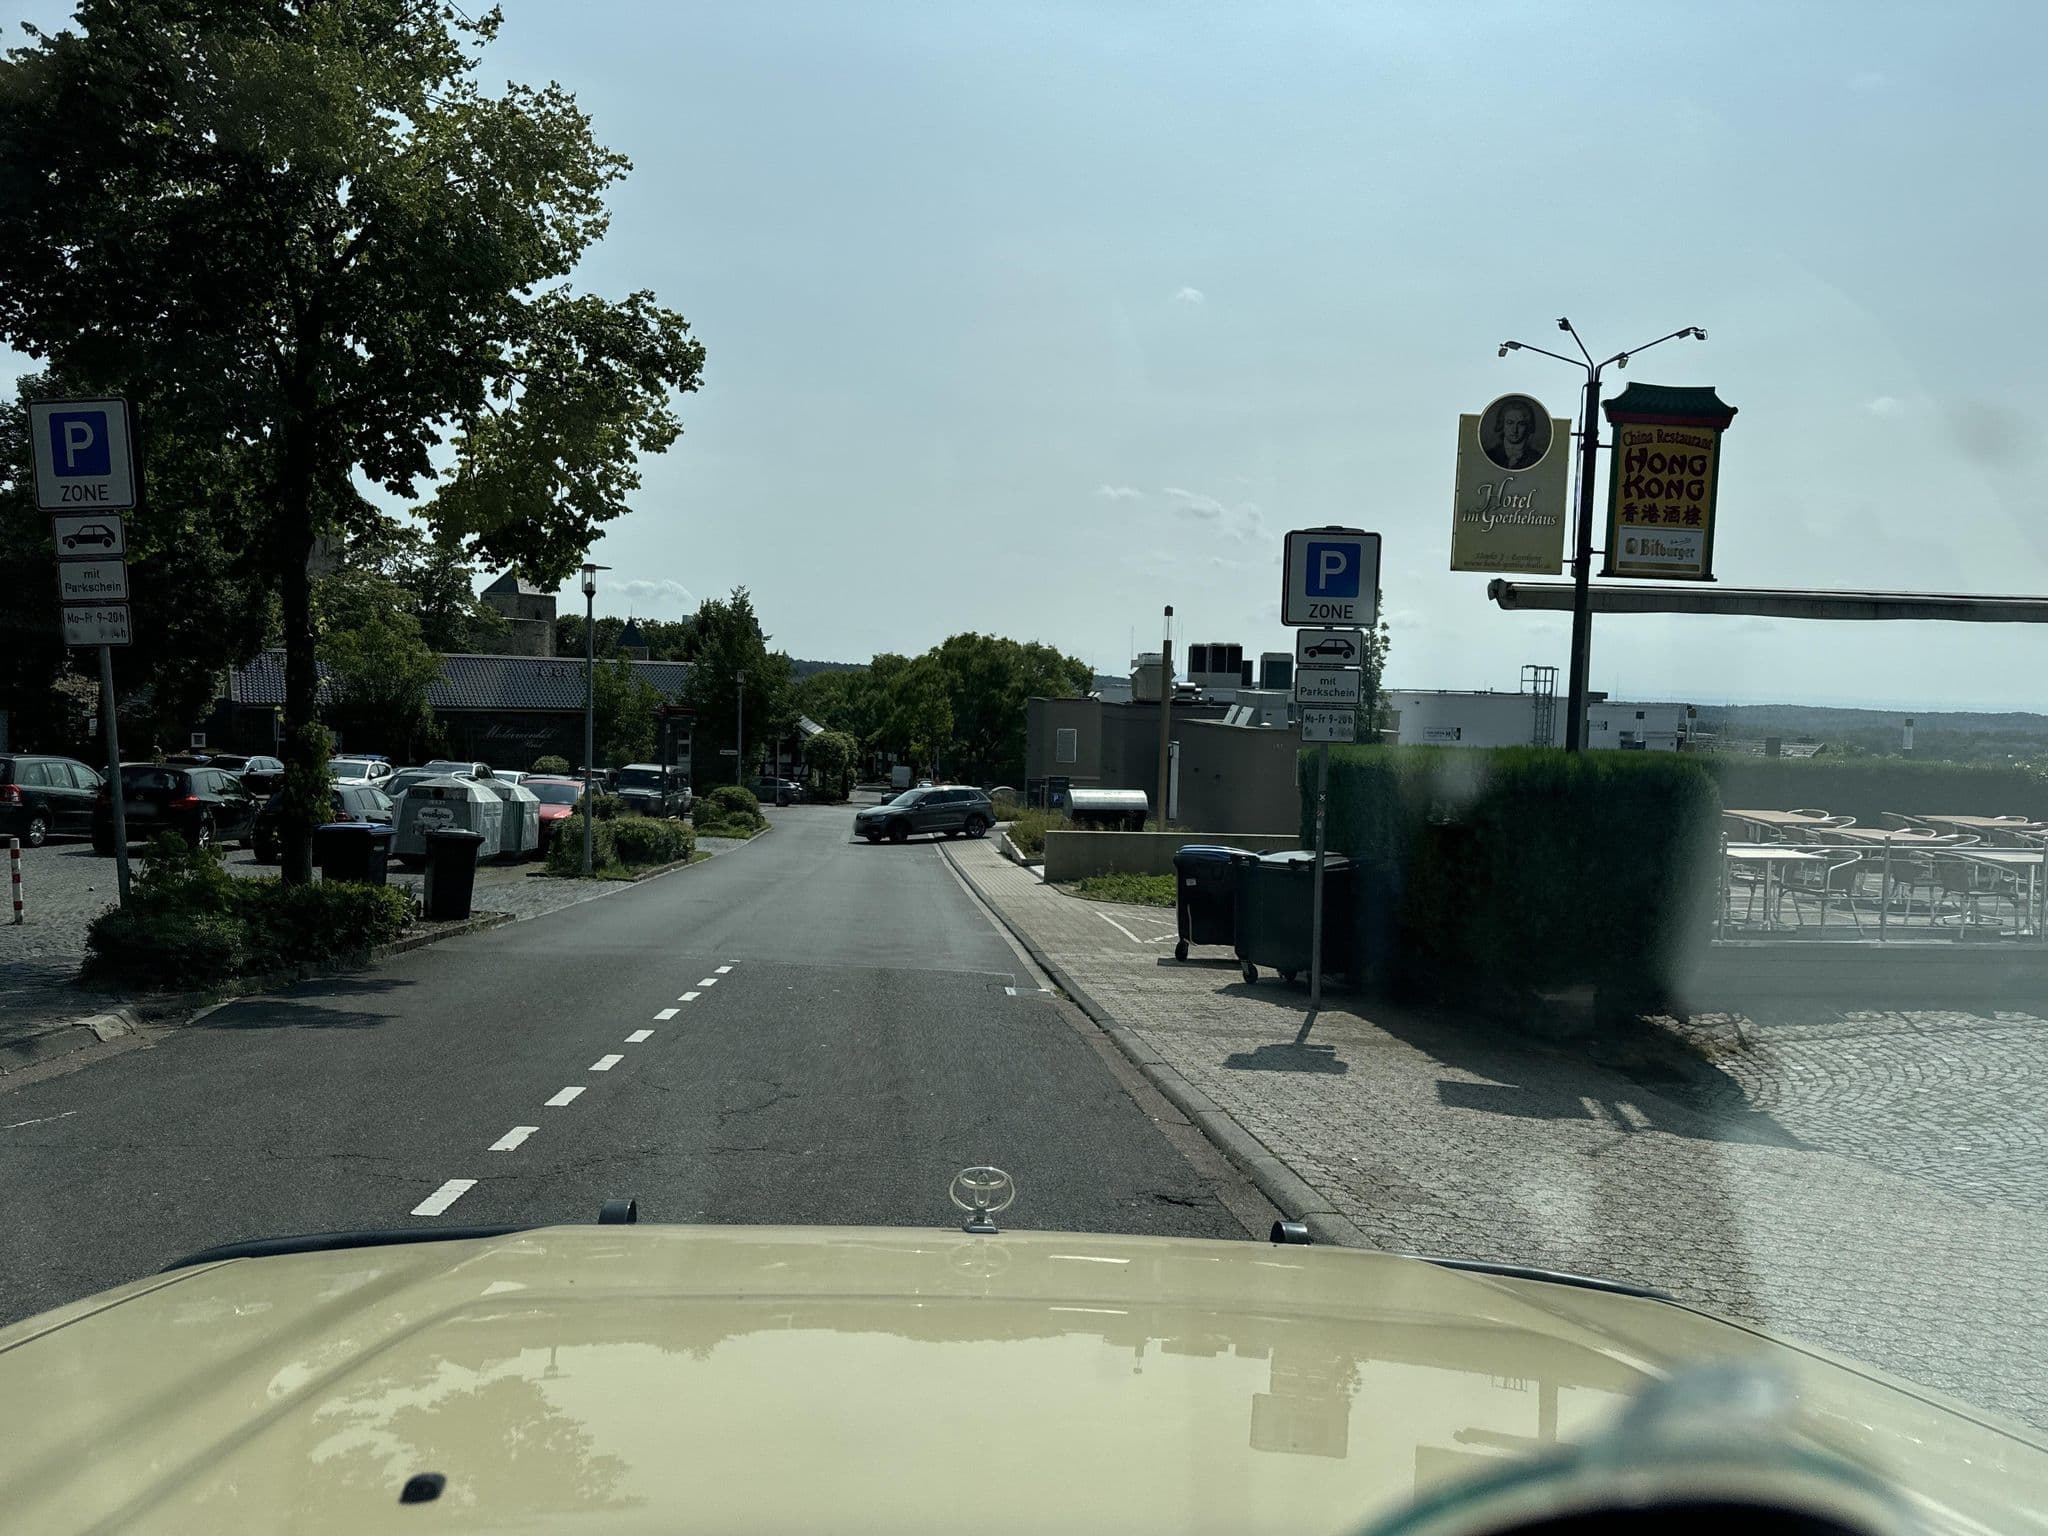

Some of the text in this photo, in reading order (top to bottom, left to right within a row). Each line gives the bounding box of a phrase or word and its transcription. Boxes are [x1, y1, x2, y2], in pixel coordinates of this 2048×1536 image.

[63, 421, 94, 468] P
[1623, 429, 1714, 450] China Restaurant
[1624, 448, 1707, 476] HONG
[60, 484, 110, 502] ZONE
[1477, 477, 1537, 511] Hotel
[1622, 474, 1705, 500] KONG
[1462, 507, 1558, 533] im Goethehaus
[1640, 538, 1695, 560] Bitburger
[83, 568, 101, 579] mit
[1318, 550, 1347, 590] P
[64, 582, 122, 593] Parkschein
[1308, 604, 1354, 619] ZONE
[1300, 686, 1355, 697] Parkschein
[1319, 676, 1337, 686] mit
